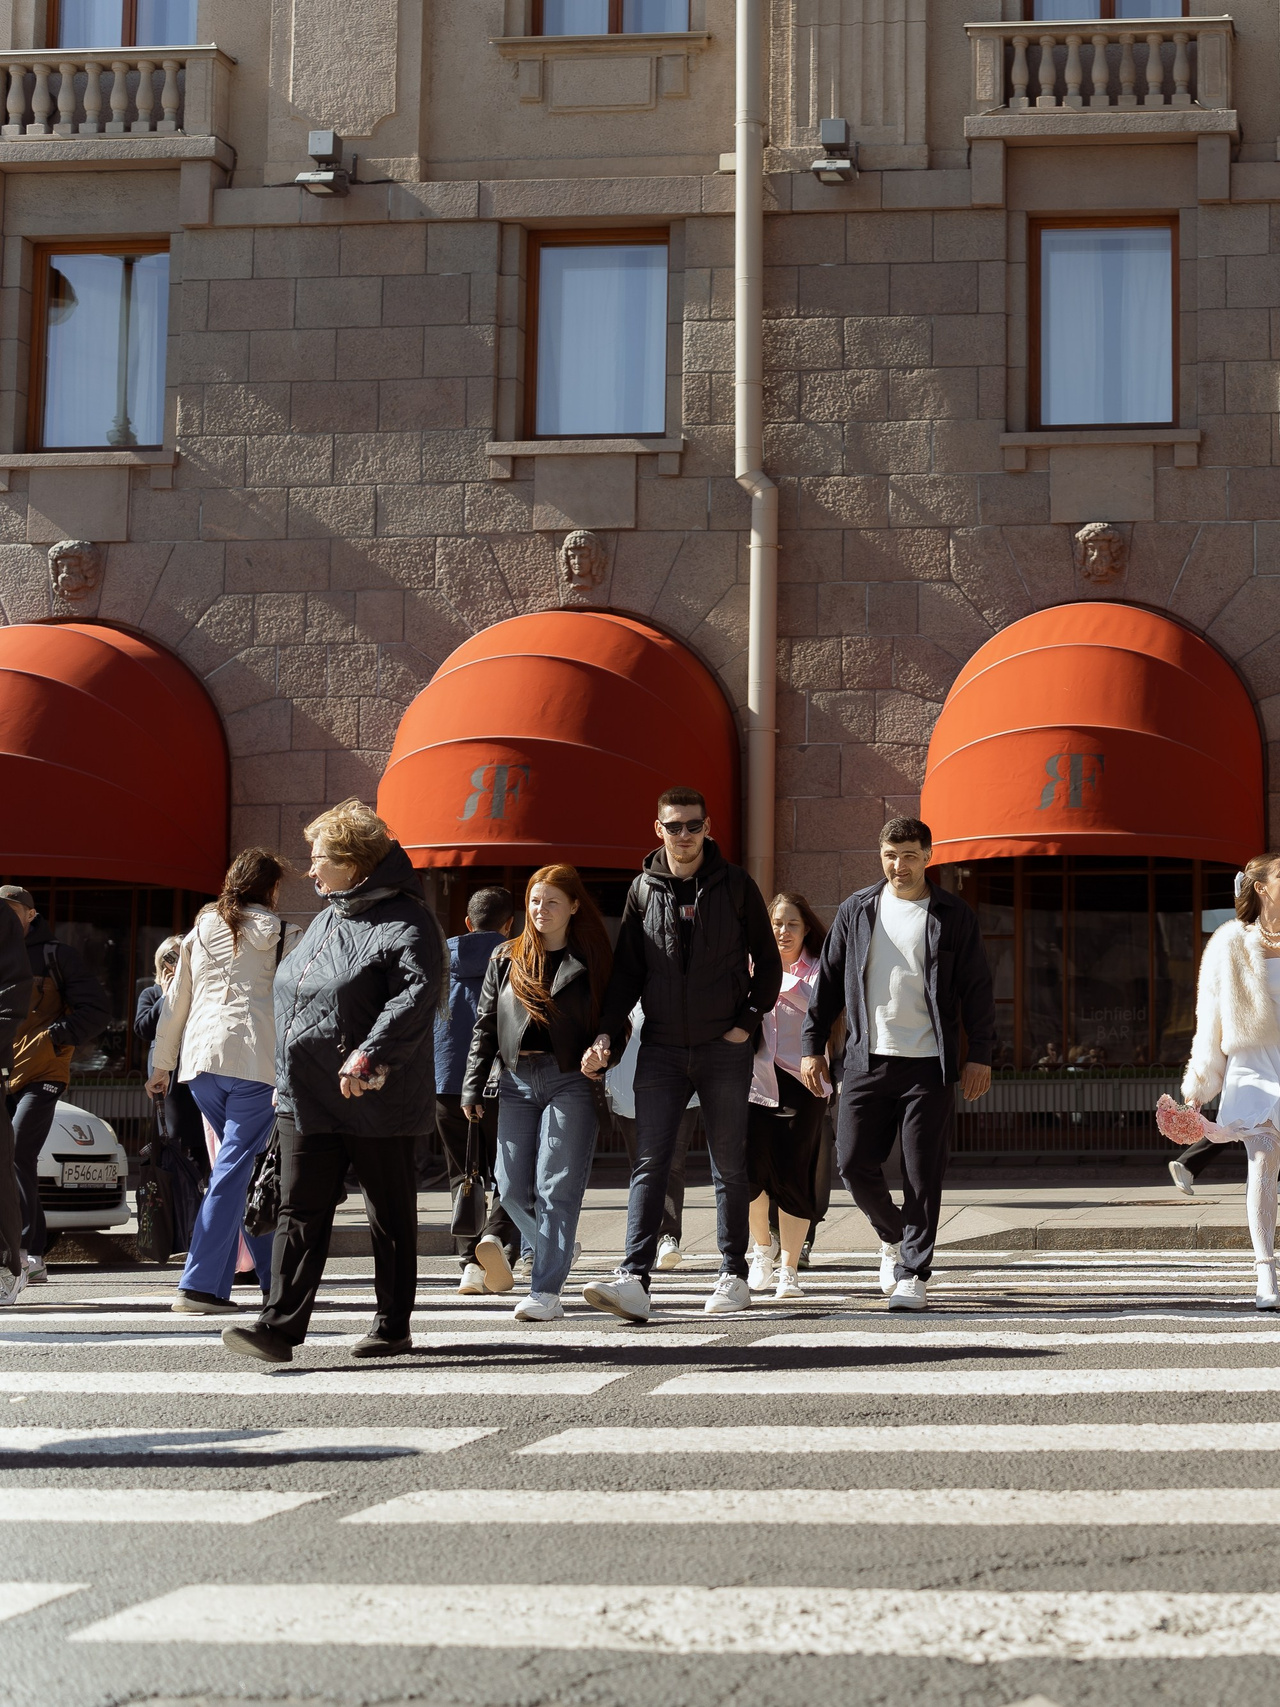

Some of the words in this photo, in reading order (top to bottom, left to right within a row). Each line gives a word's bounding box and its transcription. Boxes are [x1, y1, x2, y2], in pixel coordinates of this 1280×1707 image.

[1081, 1006, 1146, 1021] Lichfield
[1097, 1025, 1130, 1040] BAR
[96, 1035, 122, 1050] AR
[105, 1165, 117, 1177] 178
